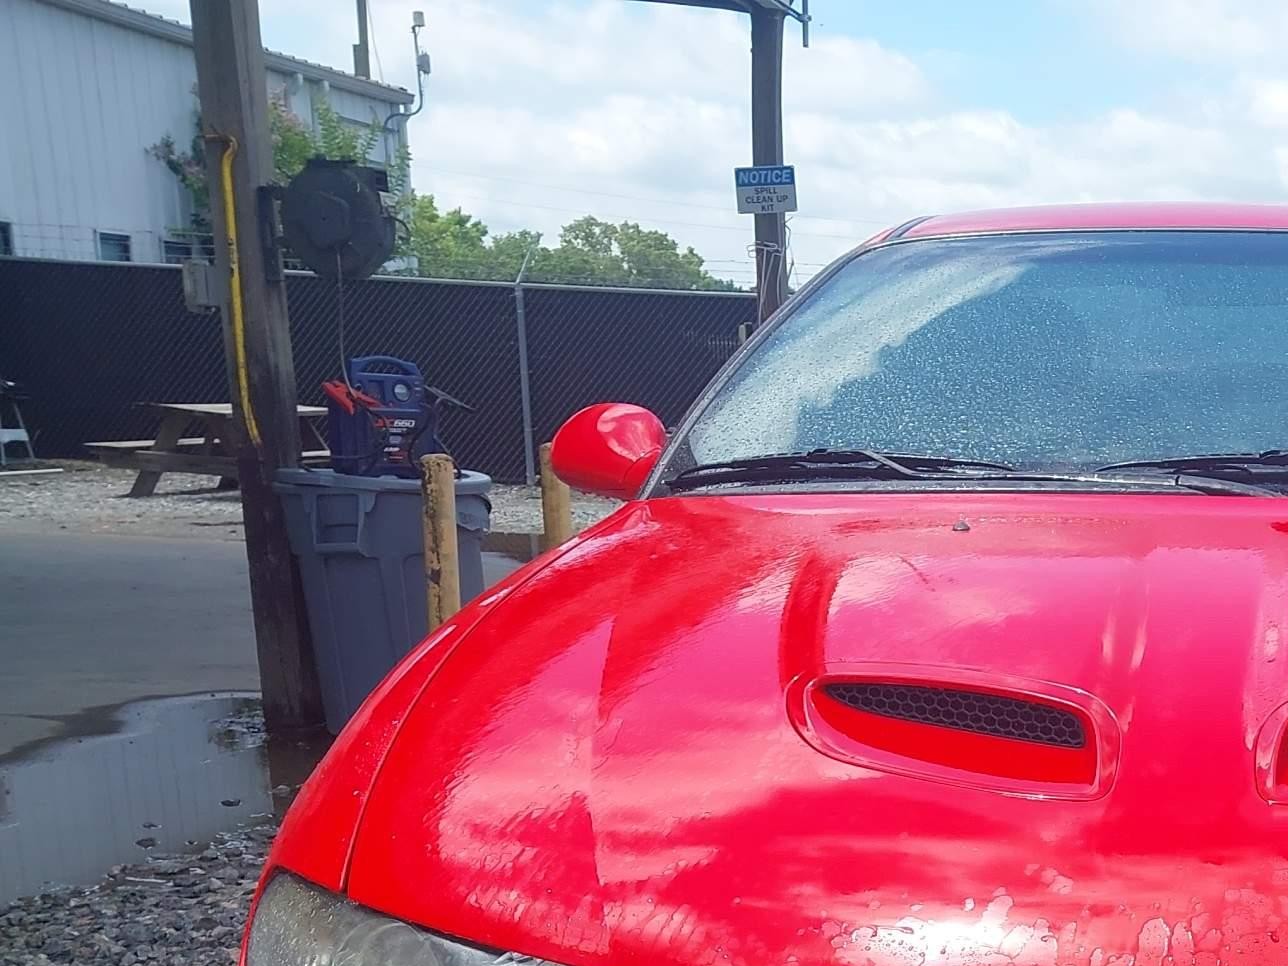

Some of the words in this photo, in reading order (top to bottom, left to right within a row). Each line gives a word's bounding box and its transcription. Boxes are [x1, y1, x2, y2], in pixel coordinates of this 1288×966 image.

[739, 169, 792, 184] NOTICE
[754, 187, 778, 195] SPILL
[745, 195, 773, 204] CLEAN
[776, 194, 788, 203] UP
[761, 204, 774, 212] KIT
